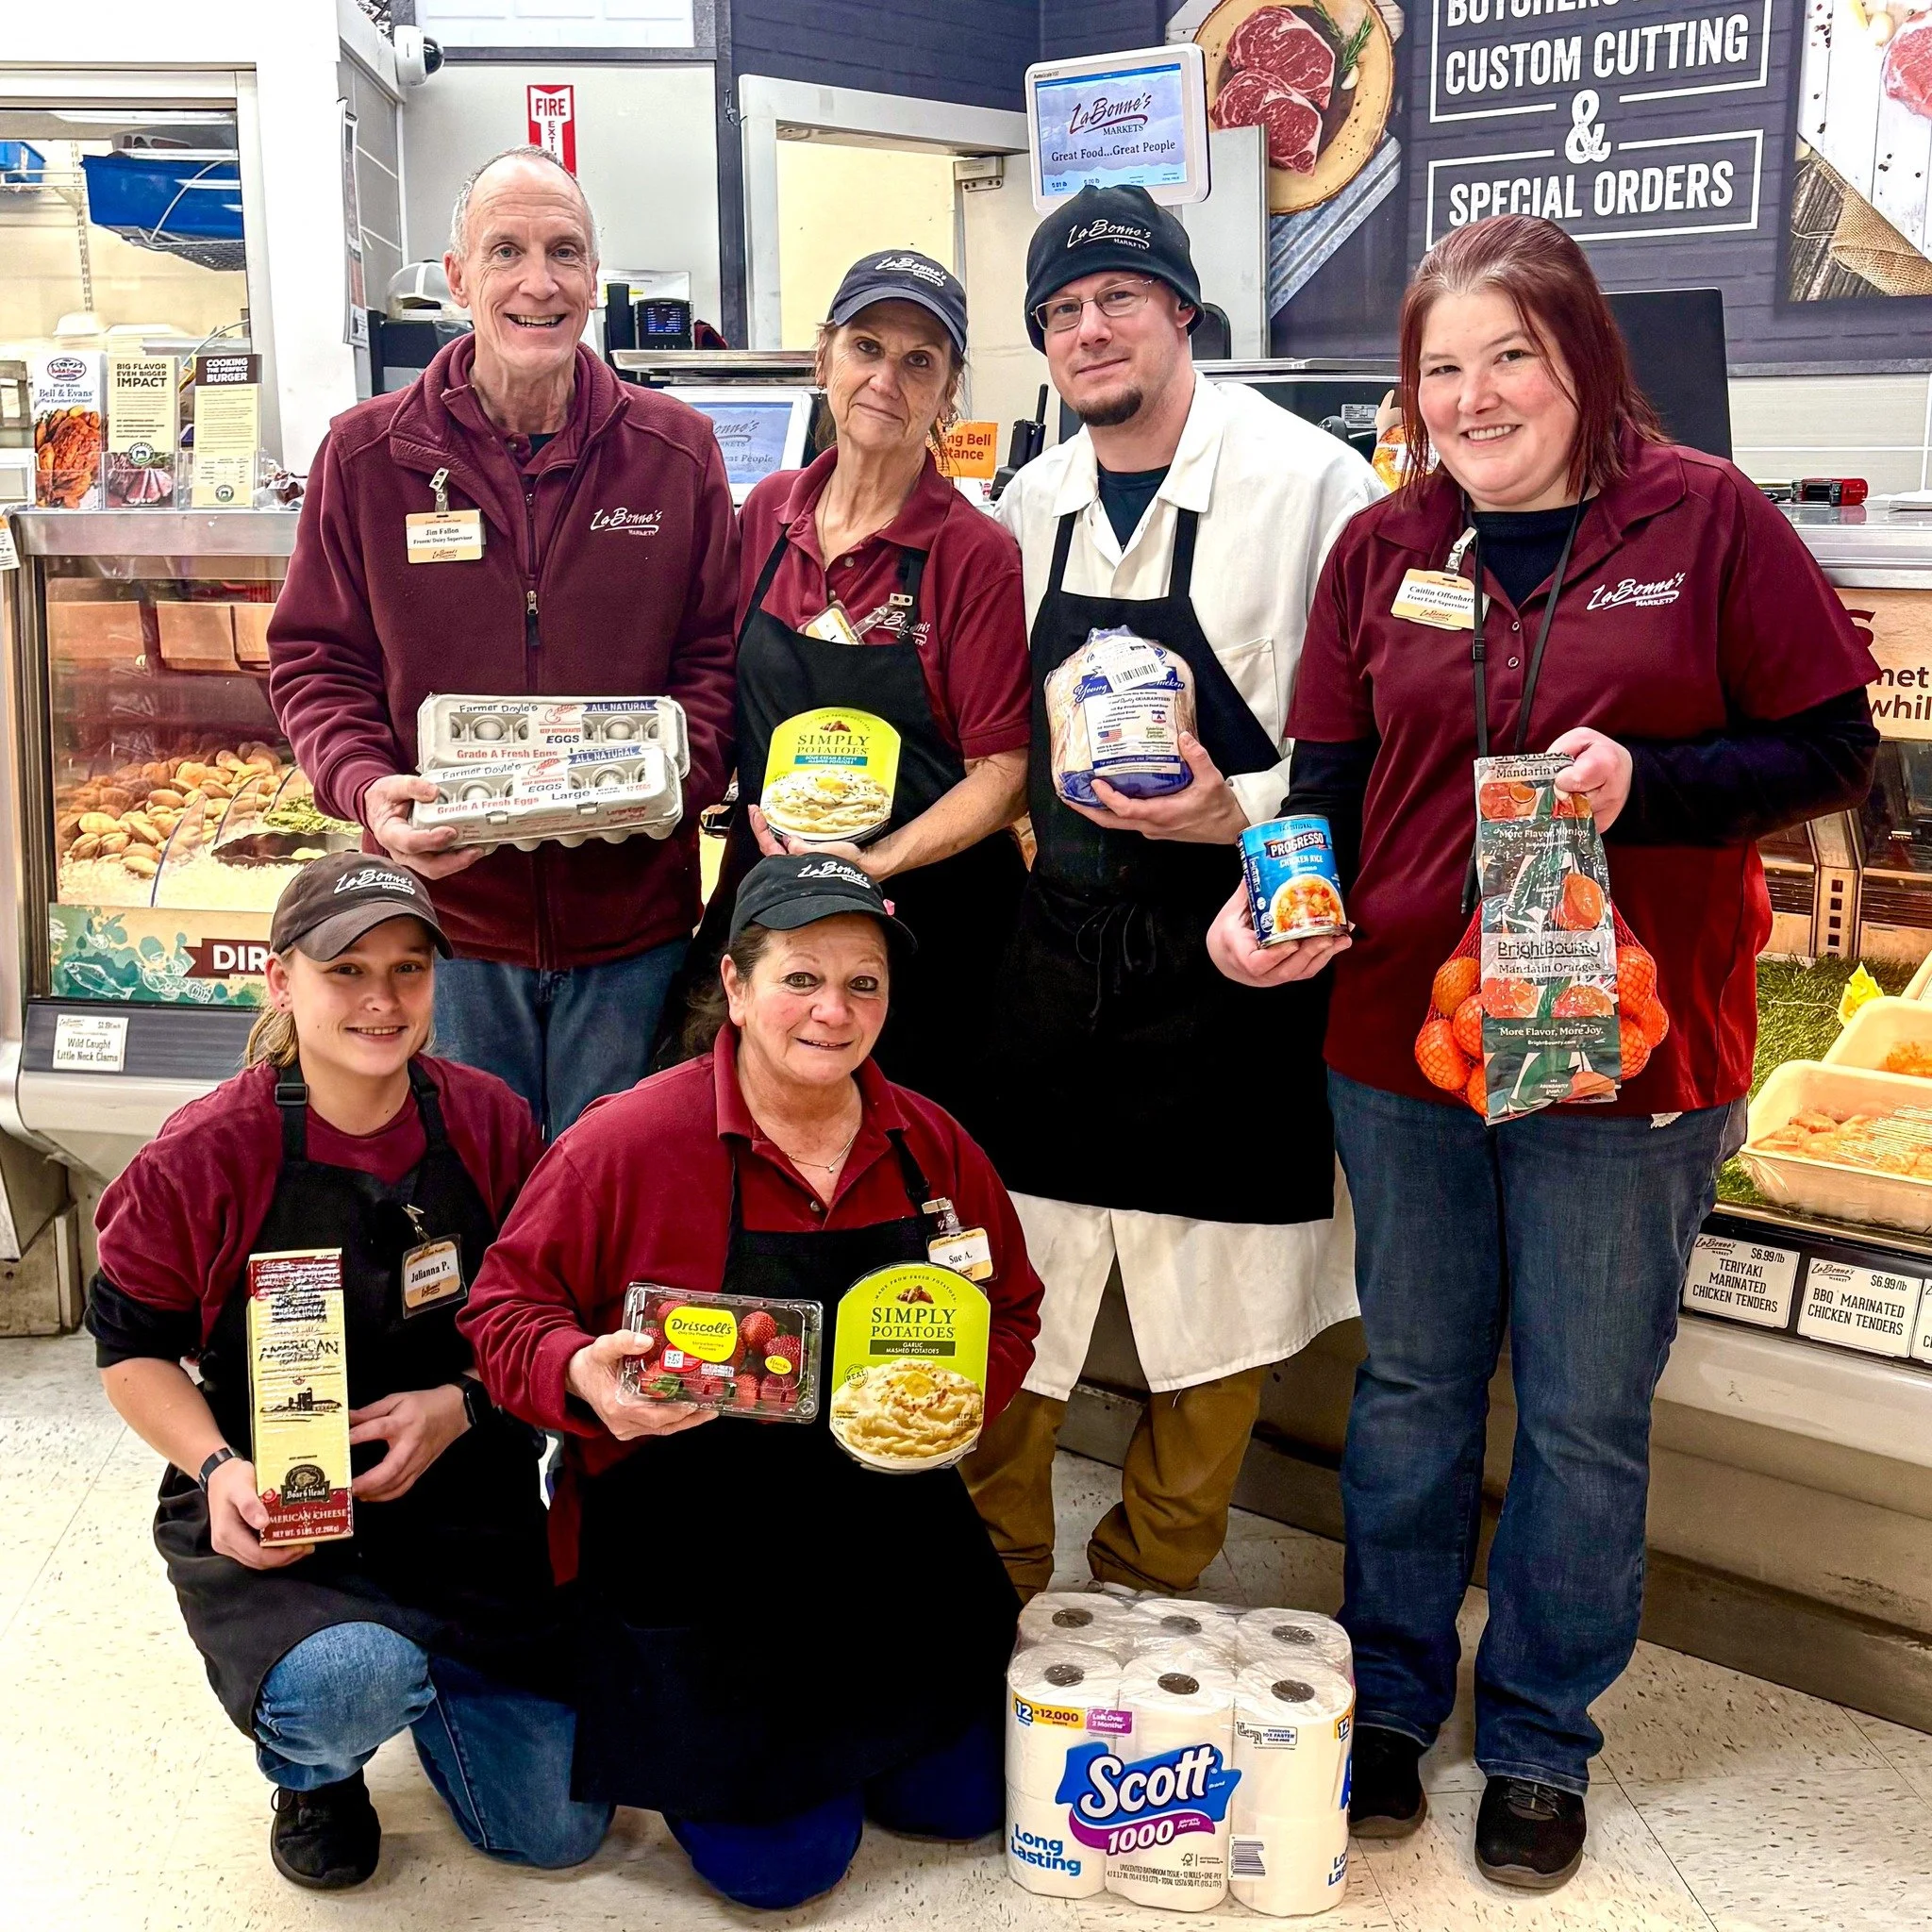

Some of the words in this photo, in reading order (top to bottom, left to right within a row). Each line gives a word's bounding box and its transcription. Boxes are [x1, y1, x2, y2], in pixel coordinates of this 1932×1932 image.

[1445, 36, 1582, 95] CUSTOM
[1593, 13, 1749, 78] CUTTING
[535, 97, 567, 117] FIRE
[1069, 92, 1152, 135] LaBonne's
[1103, 124, 1144, 136] MARKETS
[1565, 89, 1611, 164] &
[547, 121, 557, 156] EXTI
[1051, 149, 1077, 162] Great
[1143, 140, 1175, 155] People
[1449, 174, 1583, 227] SPECIAL
[1593, 160, 1734, 216] ORDERS
[1067, 219, 1152, 248] LaBonne's
[206, 358, 248, 367] COOKING
[116, 377, 167, 388] IMPACT
[206, 373, 248, 383] BURGER
[39, 389, 56, 397] Bell
[58, 389, 65, 397] &
[67, 389, 92, 397] Evans
[966, 433, 991, 446] Bell
[590, 507, 663, 530] LaBonne's
[1409, 586, 1435, 596] Caitlin
[1587, 572, 1686, 610] LaBonne's
[1074, 683, 1108, 702] Young
[459, 704, 498, 713] Farmer
[501, 704, 539, 714] Doyle's
[591, 703, 608, 711] ALL
[609, 702, 652, 710] NATURAL
[545, 735, 580, 743] EGGS
[797, 735, 870, 746] SIMPLY
[457, 750, 488, 758] Grade
[491, 750, 499, 758] A
[575, 755, 595, 763] ALL
[595, 746, 637, 760] NATURAL
[797, 746, 868, 756] POTATOES
[442, 767, 481, 780] Farmer
[484, 762, 522, 774] Doyle's
[1496, 766, 1551, 778] Mandarin
[527, 783, 562, 793] EGGS
[551, 791, 591, 801] Large
[437, 803, 468, 814] Grade
[471, 802, 478, 810] A
[481, 799, 510, 808] Fresh
[513, 796, 540, 807] Eggs
[1498, 830, 1522, 839] More
[1270, 832, 1324, 857] PROGRESSO
[1309, 855, 1324, 863] RICE
[333, 869, 413, 894] LaBonne's
[1499, 963, 1551, 974] Mandarin
[1554, 962, 1601, 974] Oranges
[1500, 1027, 1524, 1036] More
[1525, 1027, 1558, 1037] Flavor,
[1559, 1027, 1584, 1036] More
[1585, 1026, 1604, 1036] Joy.
[67, 1038, 84, 1047] Wild
[86, 1038, 111, 1052] Caught
[57, 1050, 75, 1060] Little
[77, 1051, 93, 1060] Neck
[96, 1052, 118, 1062] Clams
[1695, 1237, 1737, 1248] LaBonne's
[948, 1255, 962, 1264] Sue
[1719, 1257, 1763, 1278] TERIYAKI
[410, 1266, 441, 1283] Julianna
[441, 1260, 450, 1272] P.
[1811, 1263, 1856, 1275] LaBonne's
[1708, 1272, 1767, 1294] MARINATED
[1692, 1284, 1733, 1303] CHICKEN
[1736, 1292, 1778, 1312] TENDERS
[1812, 1288, 1834, 1304] BBQ
[1840, 1293, 1906, 1319] MARINATED
[871, 1307, 957, 1324] SIMPLY
[1807, 1304, 1853, 1324] CHICKEN
[1856, 1313, 1904, 1336] TENDERS
[671, 1318, 735, 1335] Driscoll's
[871, 1325, 955, 1338] POTATOES
[308, 1485, 325, 1497] Head
[269, 1509, 311, 1524] MERICAN
[312, 1508, 347, 1520] CHEESE
[1017, 1699, 1033, 1721] 12
[1079, 1744, 1214, 1818] Scott
[1014, 1823, 1063, 1857] Long
[1107, 1820, 1174, 1855] 1000
[1010, 1836, 1082, 1877] Lasting
[1119, 1864, 1142, 1874] UNSCENTED
[1143, 1867, 1166, 1876] BATHROOM
